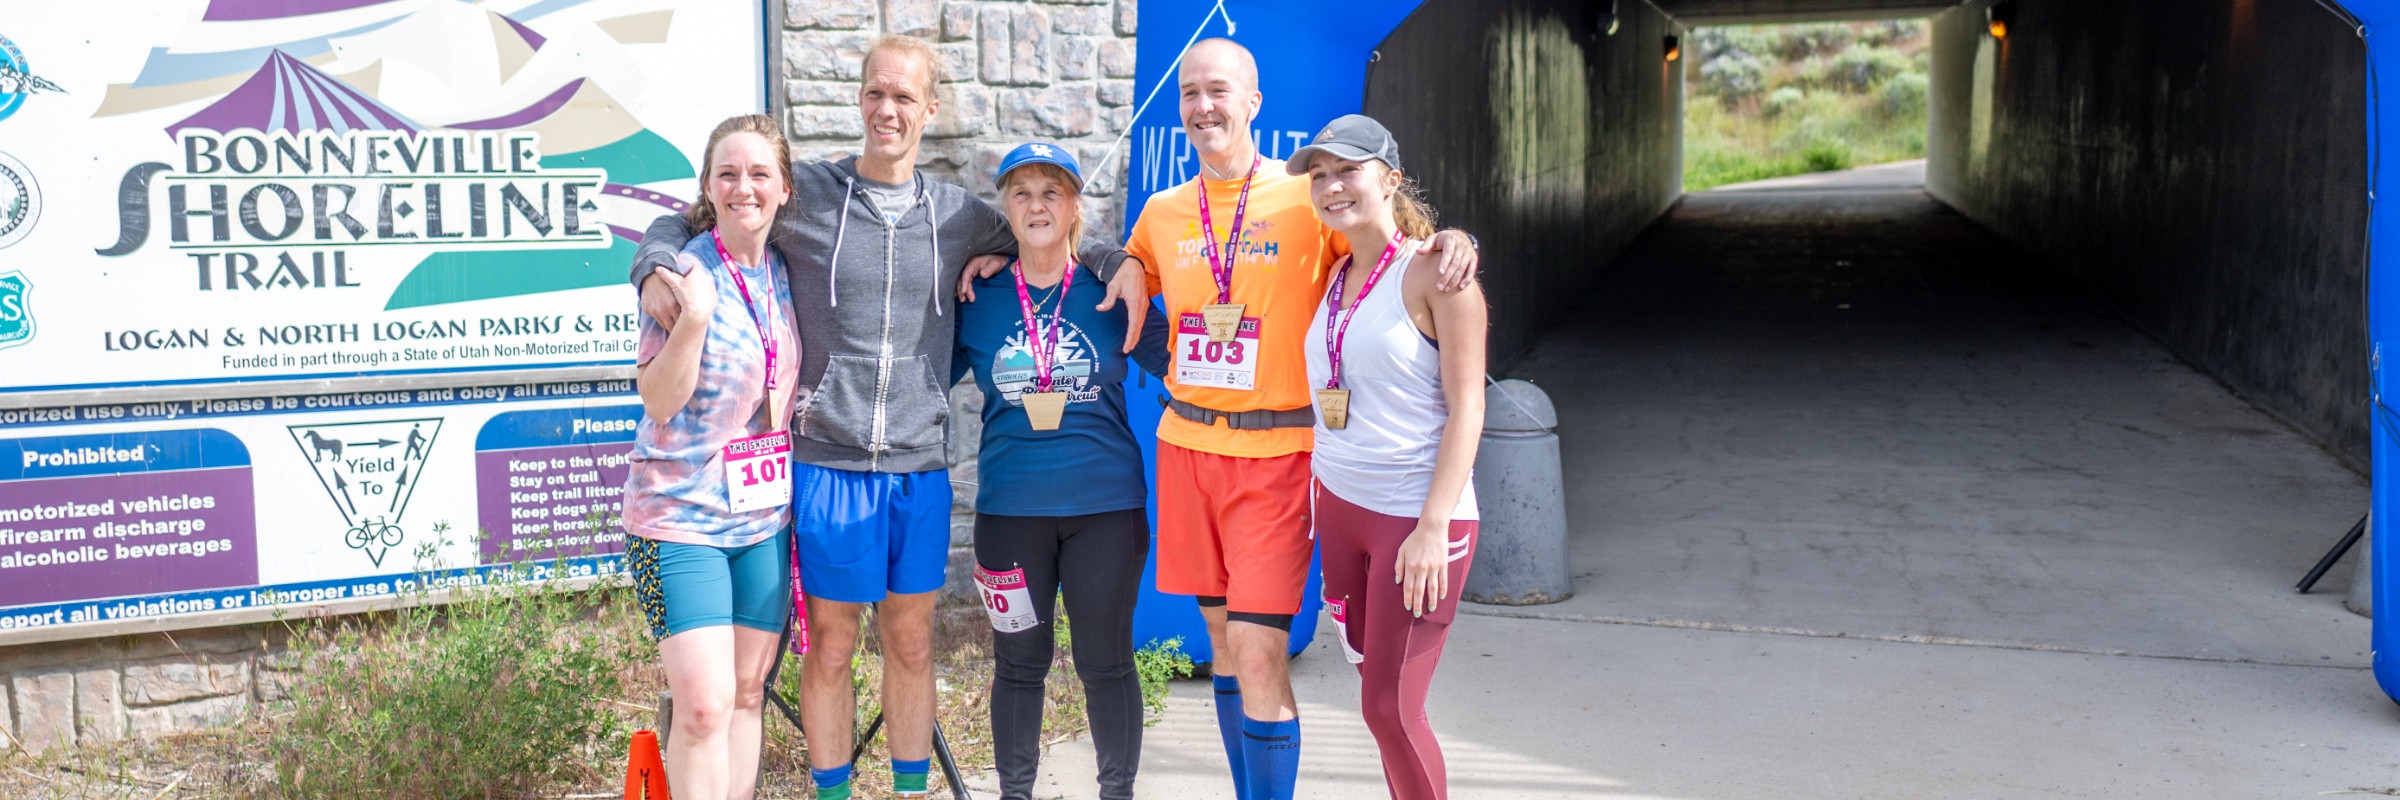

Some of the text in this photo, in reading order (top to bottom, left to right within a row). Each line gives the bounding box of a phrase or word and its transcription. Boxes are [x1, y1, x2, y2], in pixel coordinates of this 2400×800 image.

[185, 136, 538, 175] BONNEVILLE
[1143, 125, 1308, 192] WRUT
[94, 160, 602, 257] SHORELINE
[187, 250, 361, 291] TRAIL
[104, 313, 641, 351] LOGAN & NORTH LOGAN PARKS & RE
[1183, 318, 1199, 327] THE
[222, 353, 278, 369] Funded
[283, 352, 296, 366] in
[300, 352, 328, 369] part
[332, 349, 387, 368] through
[392, 351, 399, 361] a
[404, 347, 437, 361] State
[443, 345, 455, 359] of
[459, 345, 489, 359] Utah
[494, 340, 589, 357] Non-Motorized
[592, 340, 619, 353] Trail
[1188, 338, 1244, 364] 103
[1029, 366, 1081, 391] nter
[84, 406, 124, 420] use
[132, 402, 184, 419] only.
[192, 398, 265, 414] Please
[273, 396, 298, 411] be
[305, 390, 410, 408] courteous
[417, 387, 453, 402] and
[460, 385, 507, 402] obey
[513, 382, 537, 397] all
[543, 380, 591, 395] rules
[597, 378, 631, 393] and
[1059, 385, 1100, 401] ircuit
[573, 418, 636, 435] Please
[23, 445, 144, 468] Prohibited
[729, 442, 746, 453] THE
[750, 435, 788, 450] SHORELINE
[345, 456, 395, 475] Yield
[509, 453, 631, 473] Keep to the right
[741, 456, 787, 487] 107
[359, 481, 383, 496] To
[509, 470, 598, 489] Stay on trail
[0, 494, 215, 522] motorized vehicles
[511, 491, 548, 504] Keep
[552, 487, 582, 501] trail
[511, 502, 621, 519] Keep dogs on a
[0, 518, 206, 545] firearm discharge
[0, 539, 233, 568] alcoholic beverages
[0, 604, 63, 629] eport
[71, 604, 98, 622] all
[106, 597, 215, 620] violations
[222, 594, 245, 609] or
[352, 582, 389, 595] use
[394, 577, 417, 593] to
[533, 563, 592, 580] Poce
